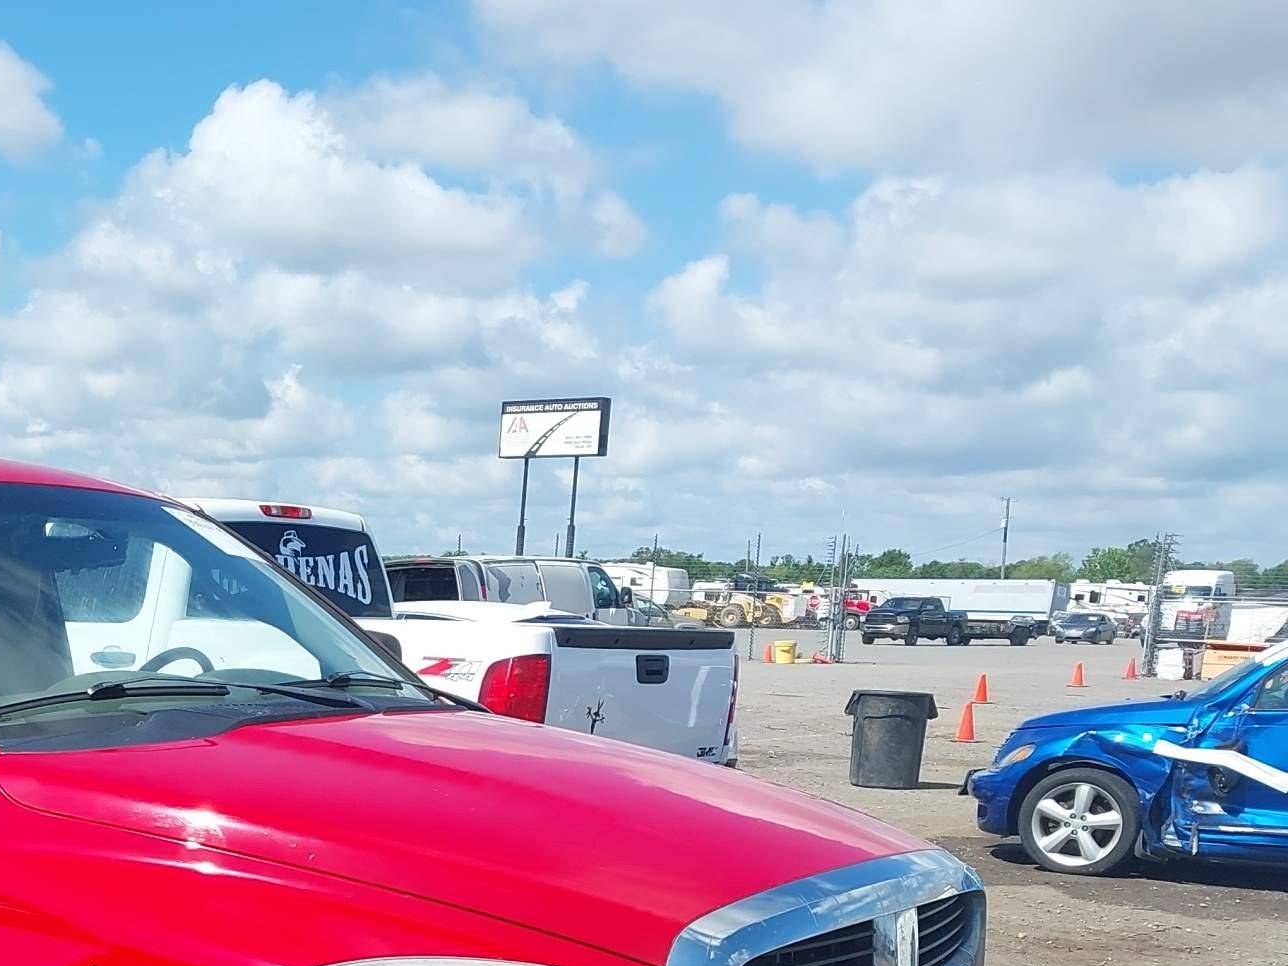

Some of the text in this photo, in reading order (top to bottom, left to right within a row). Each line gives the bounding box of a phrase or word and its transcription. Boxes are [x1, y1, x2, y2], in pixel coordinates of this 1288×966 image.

[506, 402, 599, 412] INSURANCE AUTO AUCTIONS
